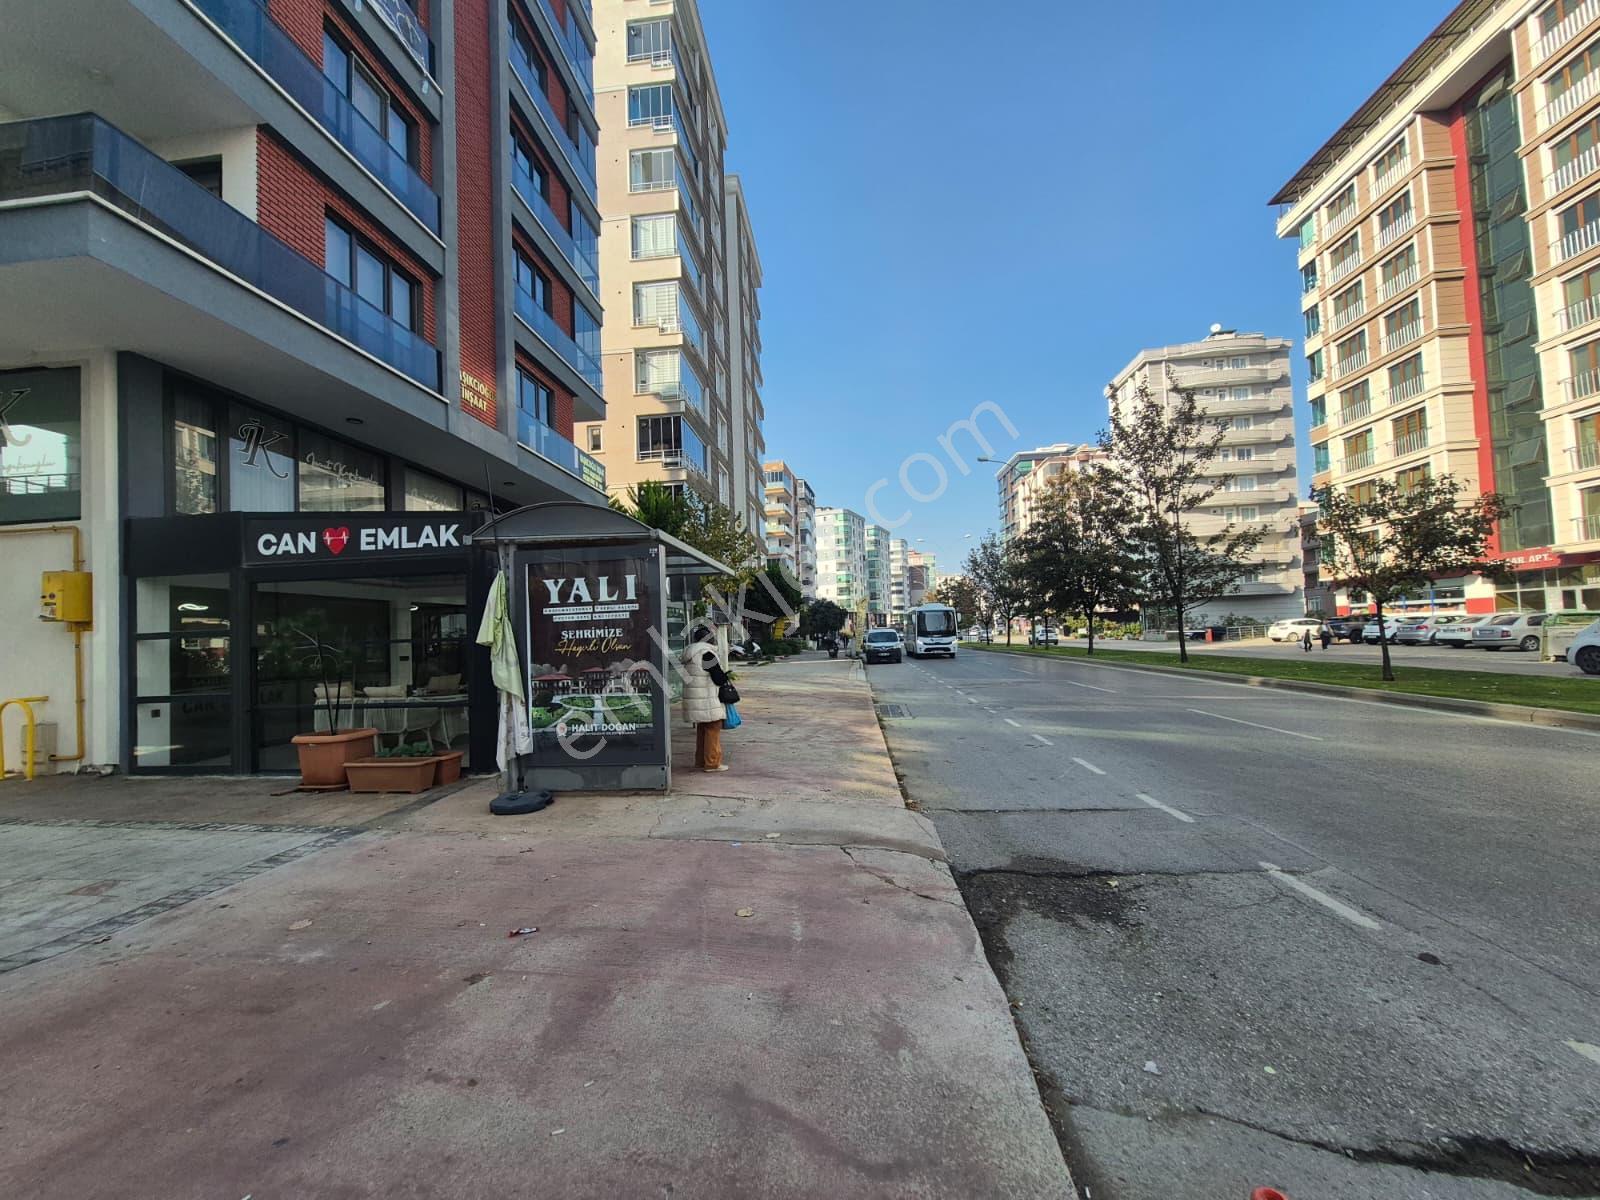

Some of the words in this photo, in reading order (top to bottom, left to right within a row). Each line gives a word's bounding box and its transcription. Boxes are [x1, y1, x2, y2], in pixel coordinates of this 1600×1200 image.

[257, 531, 317, 556] CAN
[359, 523, 460, 551] EMLAK
[542, 574, 638, 604] YALI
